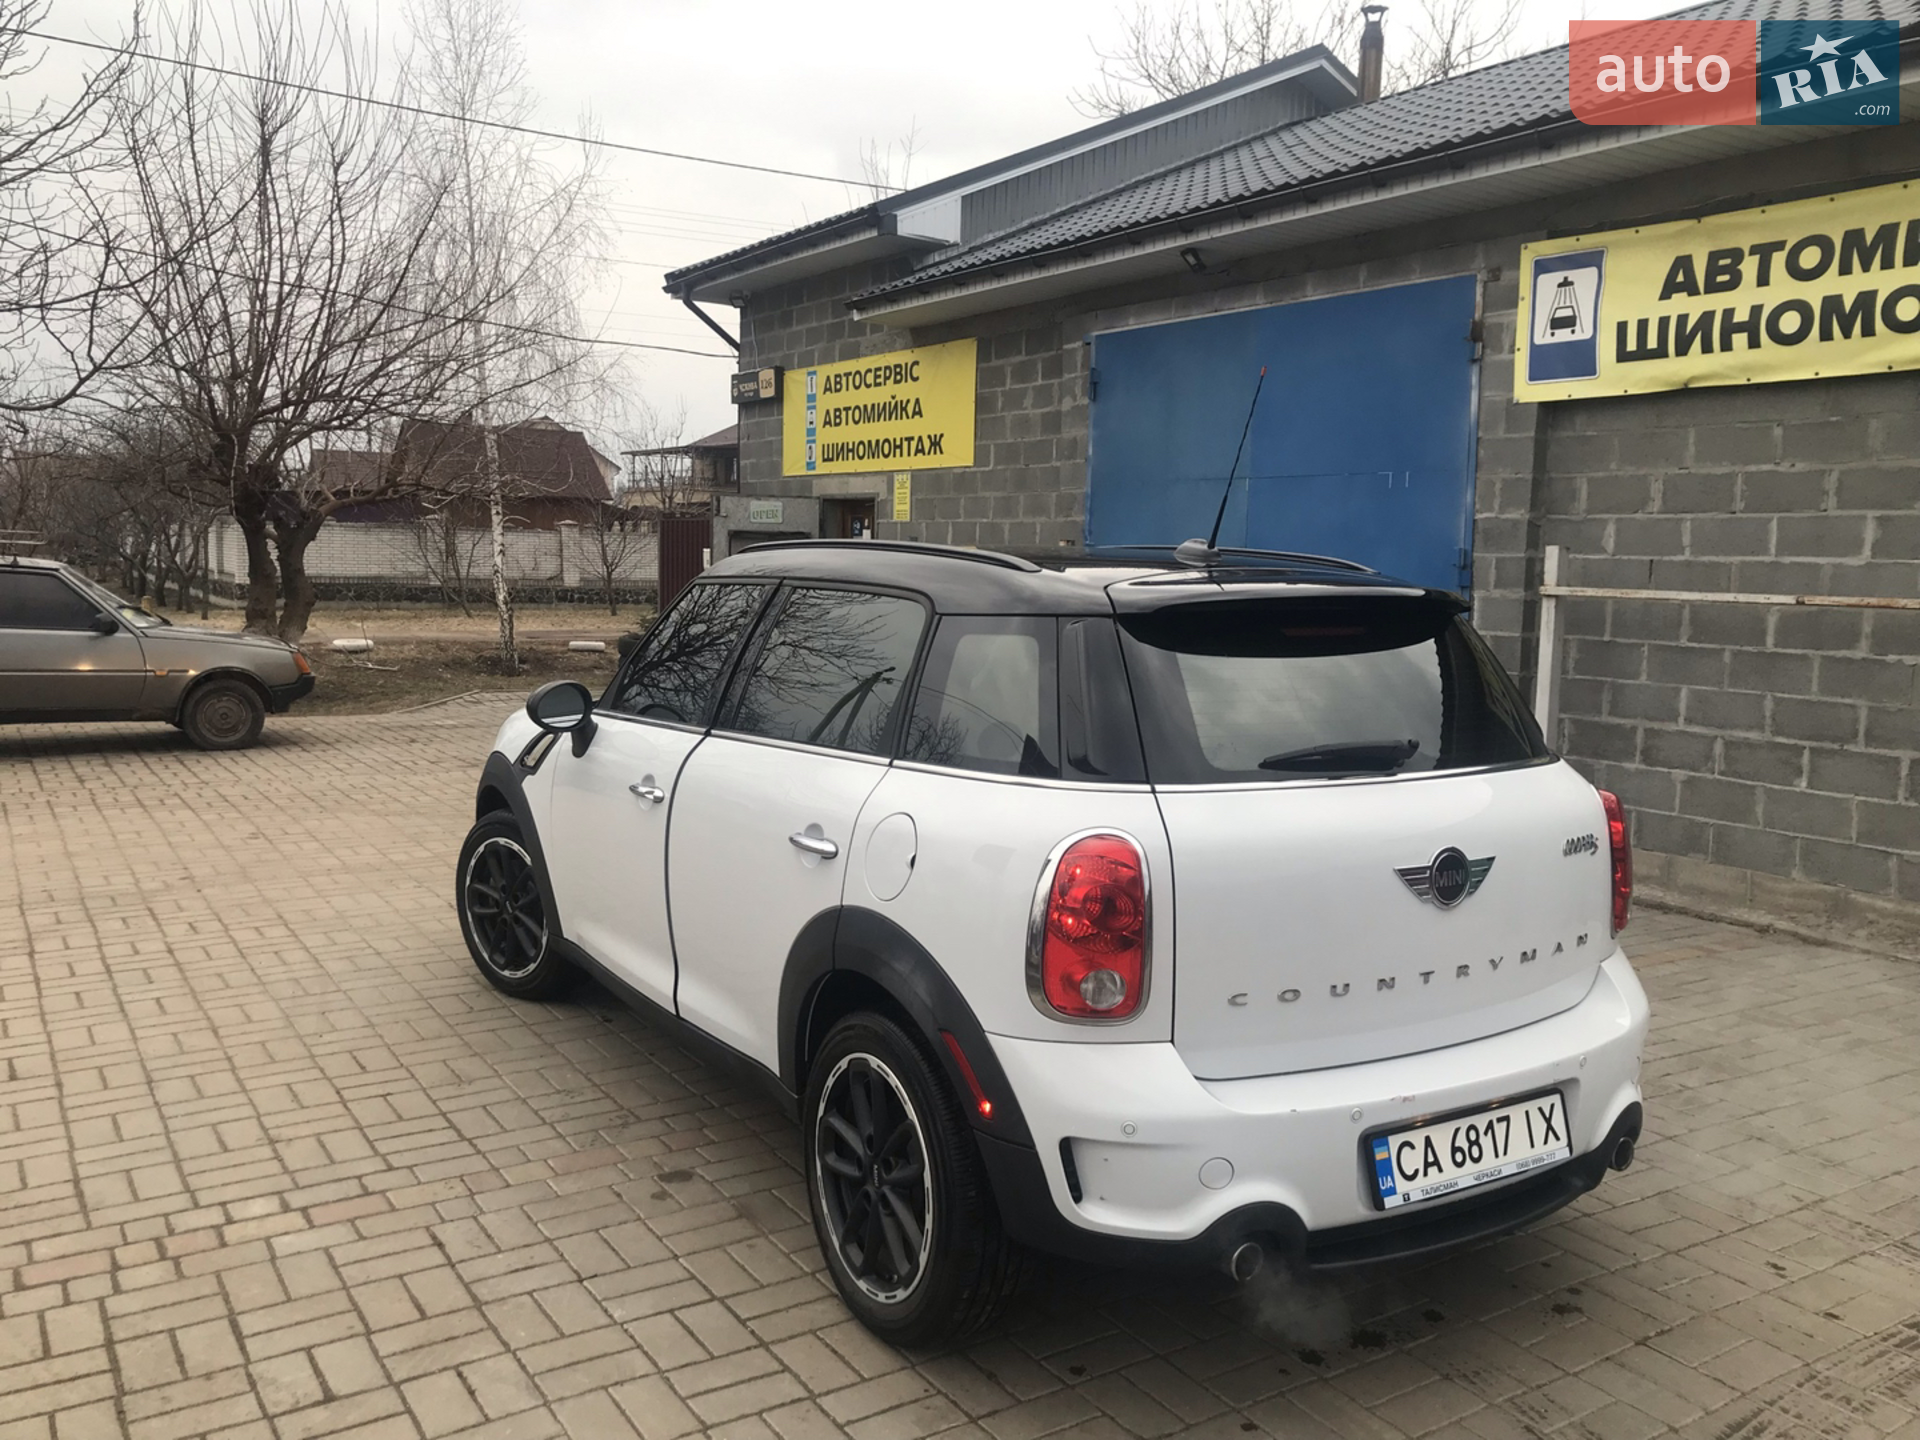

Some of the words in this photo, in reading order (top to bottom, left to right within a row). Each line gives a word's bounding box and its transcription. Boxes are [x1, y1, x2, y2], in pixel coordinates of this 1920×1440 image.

[1616, 283, 1920, 363] ШИНОМО
[822, 360, 920, 395] АВТОСЕРВІС
[822, 395, 924, 428] АВТОМИЙКА
[821, 433, 945, 463] ШИНОМОНТАЖ
[1435, 869, 1465, 888] MINI
[1226, 932, 1589, 1007] COUNTRYMAN
[1396, 1135, 1444, 1182] CA
[1450, 1114, 1511, 1168] 6817
[1524, 1103, 1561, 1149] IX
[1378, 1175, 1394, 1190] UA
[1420, 1181, 1459, 1197] ТАЛИСМАН
[1472, 1168, 1503, 1183] ЧЕРКАСИ
